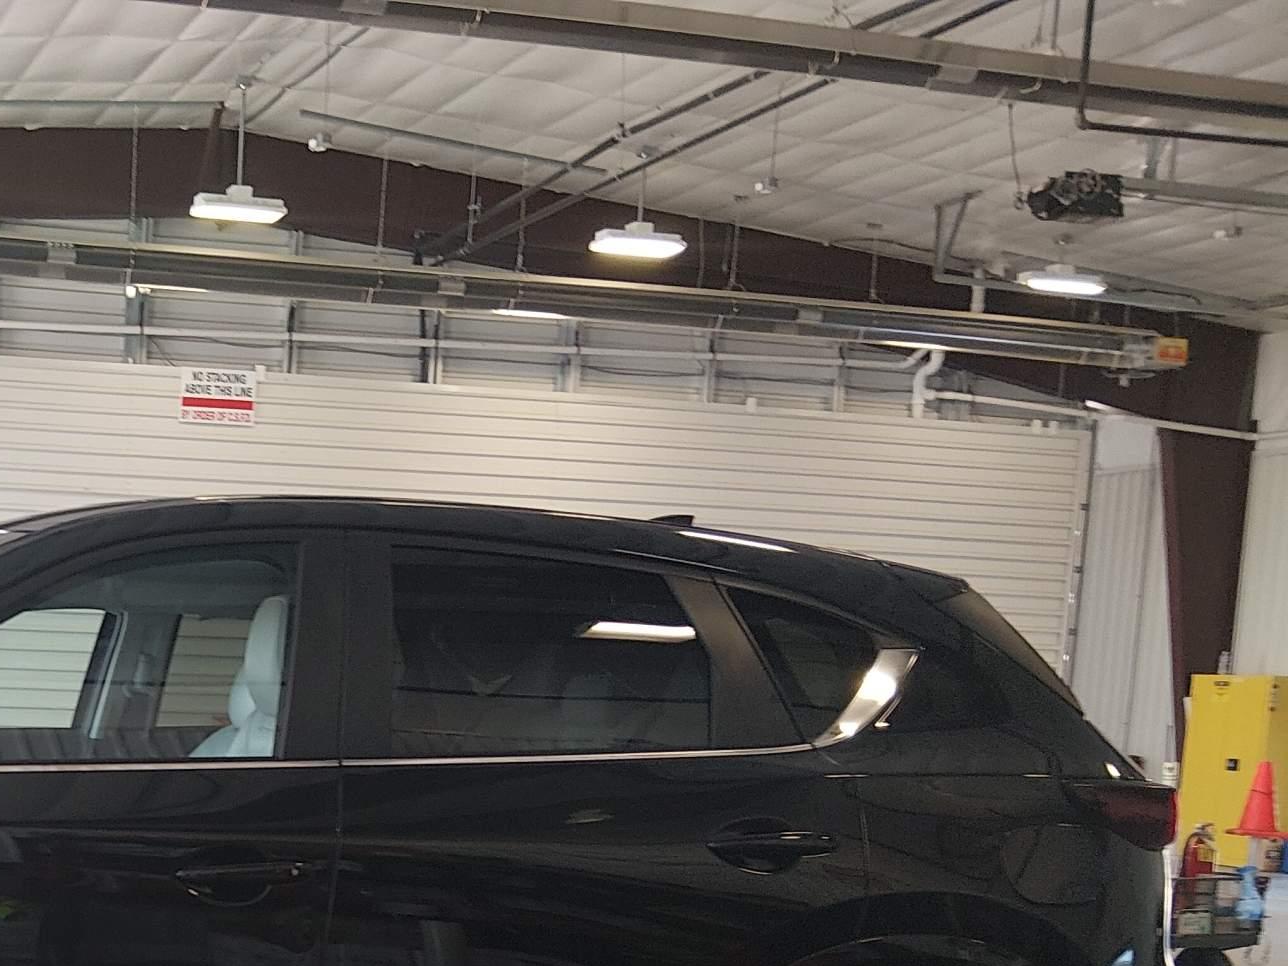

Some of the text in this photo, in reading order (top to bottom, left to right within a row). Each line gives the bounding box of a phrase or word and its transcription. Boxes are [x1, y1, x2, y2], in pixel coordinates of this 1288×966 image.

[192, 371, 247, 385] NO STACKING
[185, 383, 253, 398] ABOVE THIS LINE
